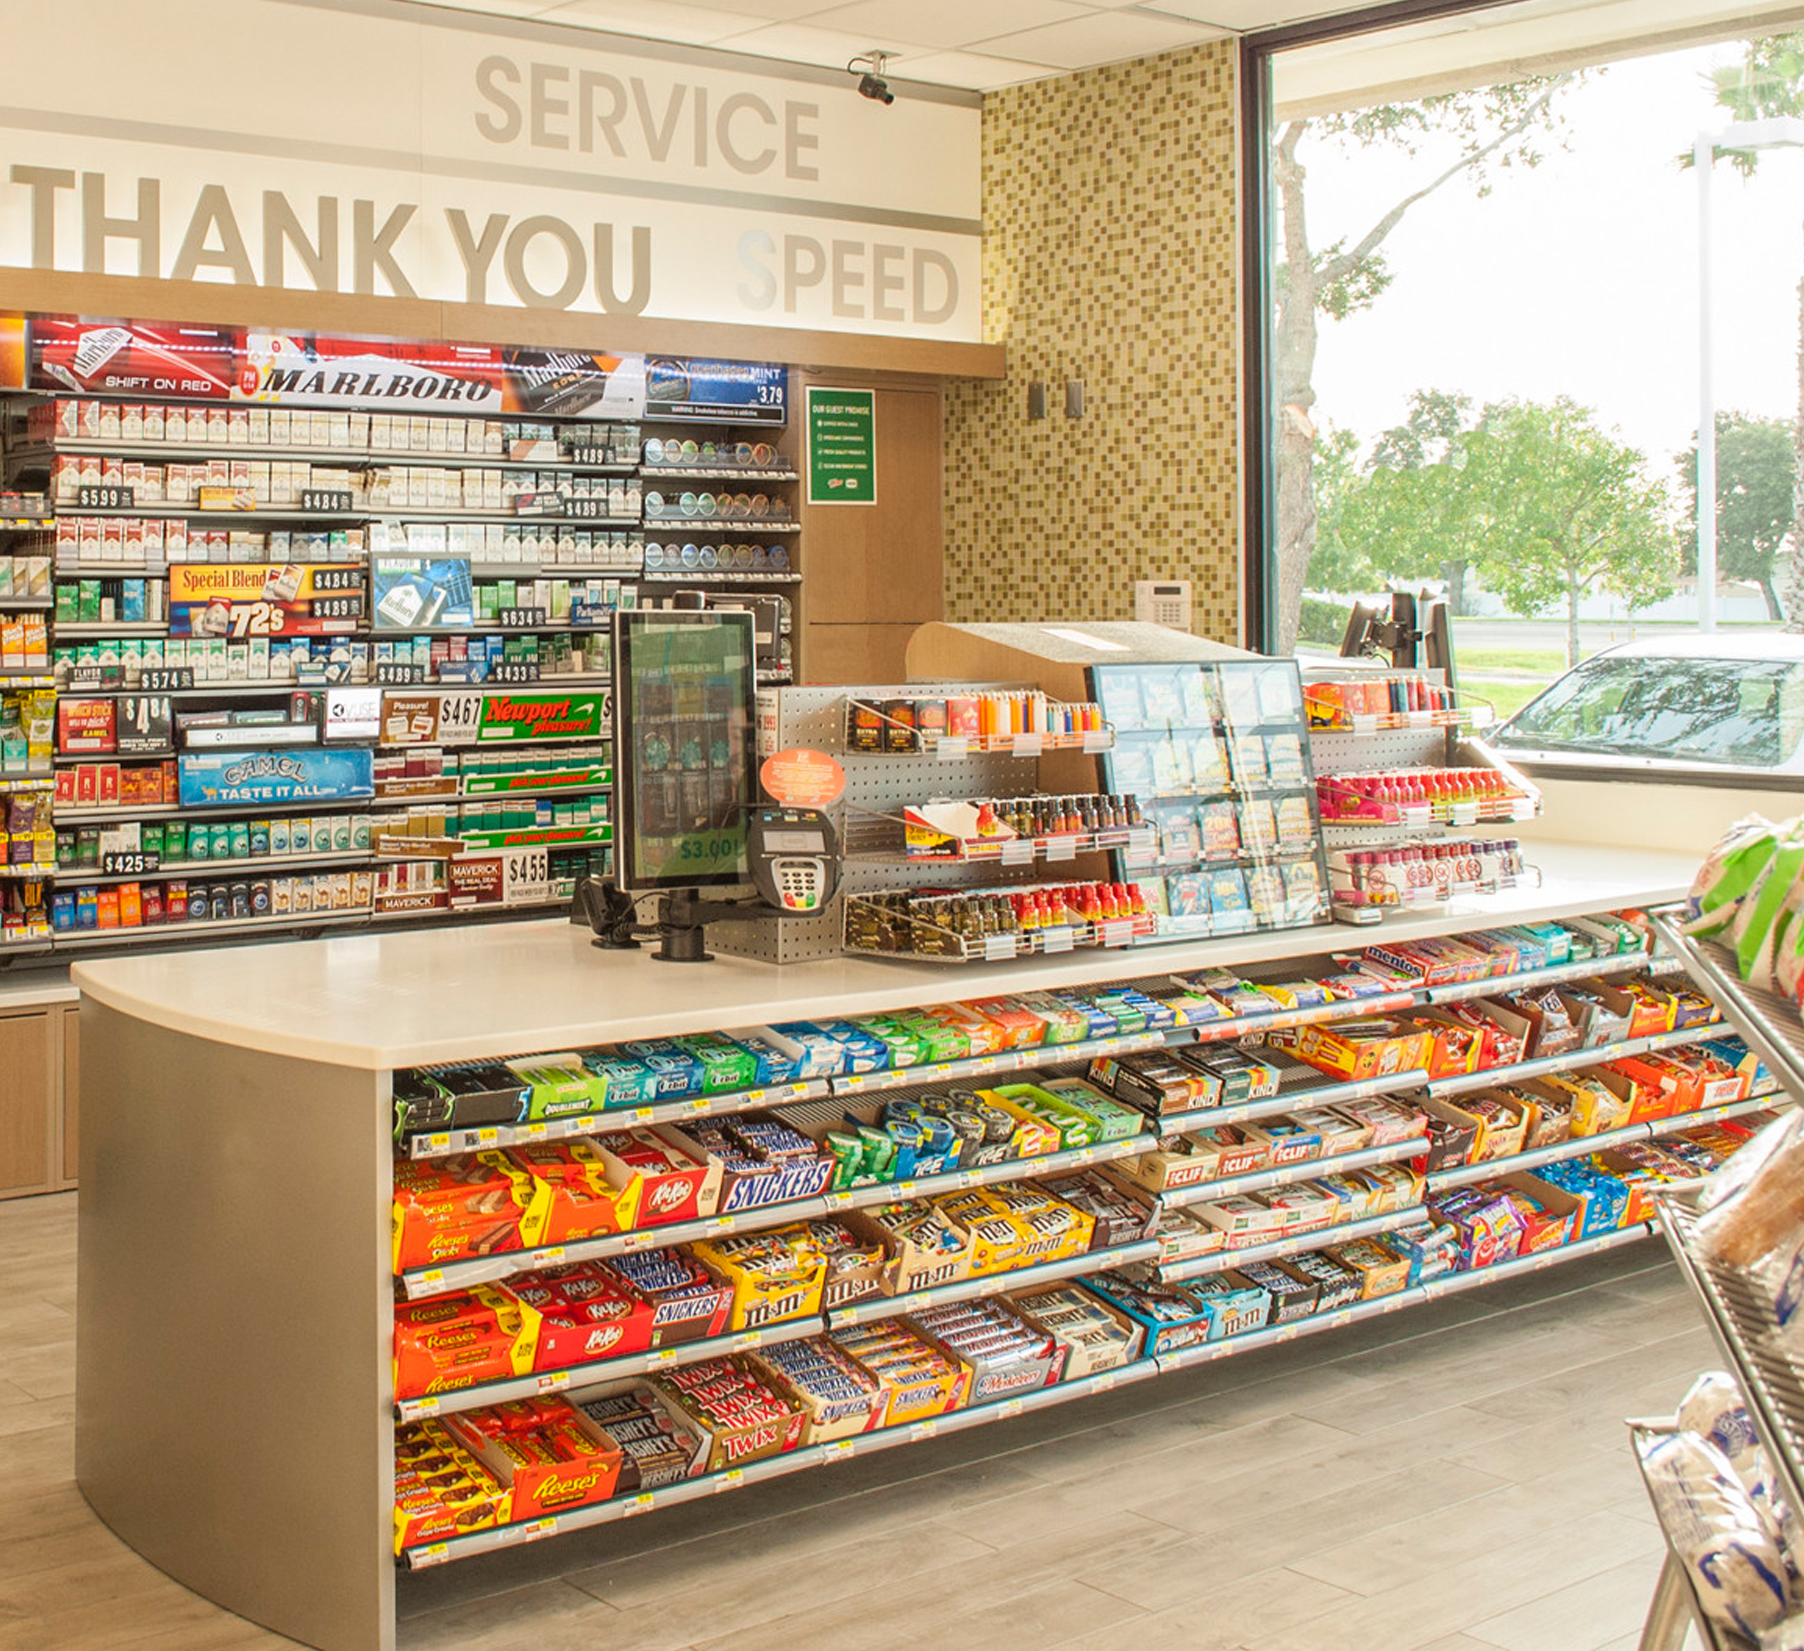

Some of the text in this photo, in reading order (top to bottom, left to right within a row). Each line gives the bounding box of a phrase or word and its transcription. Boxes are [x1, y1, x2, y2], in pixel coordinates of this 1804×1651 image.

[474, 55, 819, 182] SERVICE
[11, 164, 652, 316] THANK YOU
[737, 228, 959, 325] SPEED
[750, 368, 782, 380] MINT
[105, 376, 212, 392] SHIFT ON RED
[260, 368, 494, 401] MARLBORO
[183, 569, 267, 591] Special Blend
[230, 602, 284, 637] 72's
[393, 701, 429, 711] Pleasure!
[485, 697, 571, 725] Newport
[532, 717, 592, 737] pleasure!
[224, 755, 307, 786] CAMEL
[509, 773, 588, 789] pick your pleasure!
[219, 785, 321, 800] TASTE IT ALL
[504, 831, 523, 845] pick
[453, 864, 498, 877] MAVERICK
[385, 896, 432, 909] MAVERICK
[1368, 946, 1423, 978] mentos
[658, 1077, 689, 1093] Orbit
[711, 1073, 740, 1087] Orbit
[1090, 1067, 1116, 1088] KIND
[610, 1088, 640, 1103] Orbit
[1247, 1084, 1275, 1098] KIND
[545, 1098, 591, 1117] DOUBLEMINT
[1187, 1094, 1214, 1109] KIND
[1281, 1145, 1308, 1161] CLIF
[1227, 1157, 1253, 1173] CLIF
[1175, 1168, 1203, 1184] CLIF
[726, 1163, 830, 1211] SNICKERS
[637, 1270, 691, 1292] SNICKERS
[655, 1296, 719, 1324] SNICKERS
[427, 1332, 477, 1349] Reese's
[425, 1374, 474, 1394] Reese's
[807, 1376, 851, 1395] SNICKERS
[895, 1383, 941, 1407] SNICKERS
[820, 1397, 871, 1421] SNICKERS
[532, 1473, 600, 1500] Reese's
